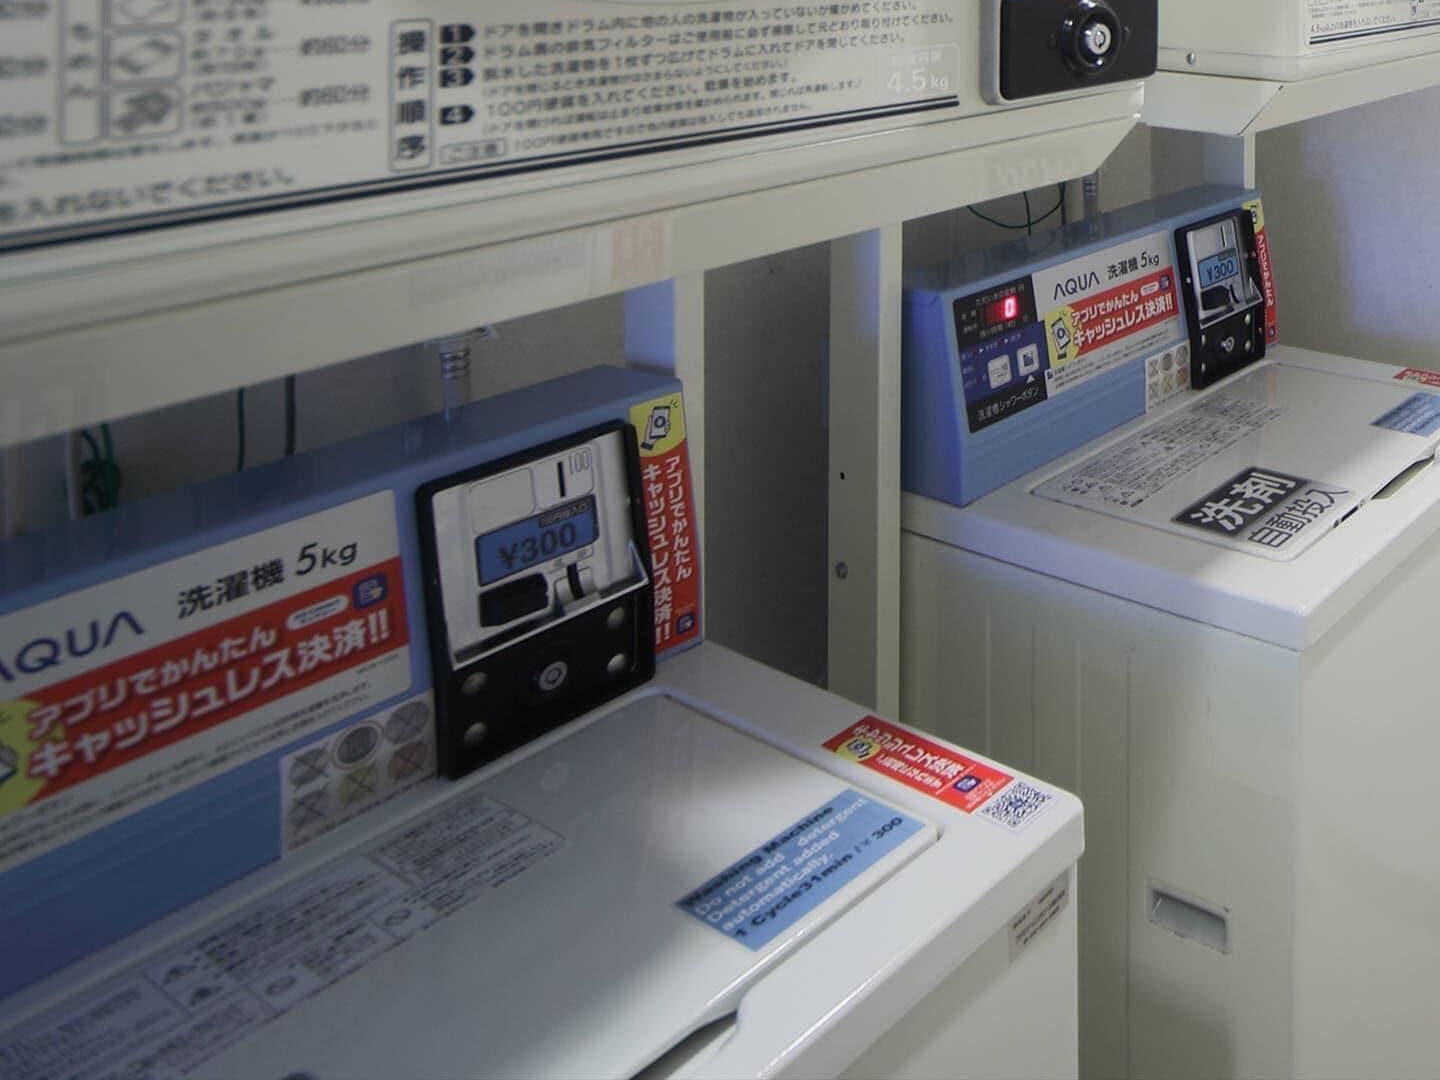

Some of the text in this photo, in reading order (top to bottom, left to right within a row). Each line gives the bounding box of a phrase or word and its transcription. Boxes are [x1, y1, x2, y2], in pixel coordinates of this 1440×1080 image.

[1053, 251, 1160, 301] AQUA 洗濯機 5kg
[1205, 259, 1234, 281] ¥300
[1003, 296, 1018, 319] 0
[1071, 289, 1139, 326] アプリでかんたん
[1073, 292, 1174, 347] キャッシュレス決済!!
[664, 454, 692, 583] アプリでかんたん
[1190, 471, 1297, 532] 洗剤
[1247, 487, 1350, 548] 自動投入
[500, 522, 577, 571] ¥300
[177, 557, 285, 620] 洗濯機
[295, 541, 358, 577] 5kg
[29, 623, 278, 740] アプリでかんたん
[29, 608, 391, 778] キャッシュレス決済!!
